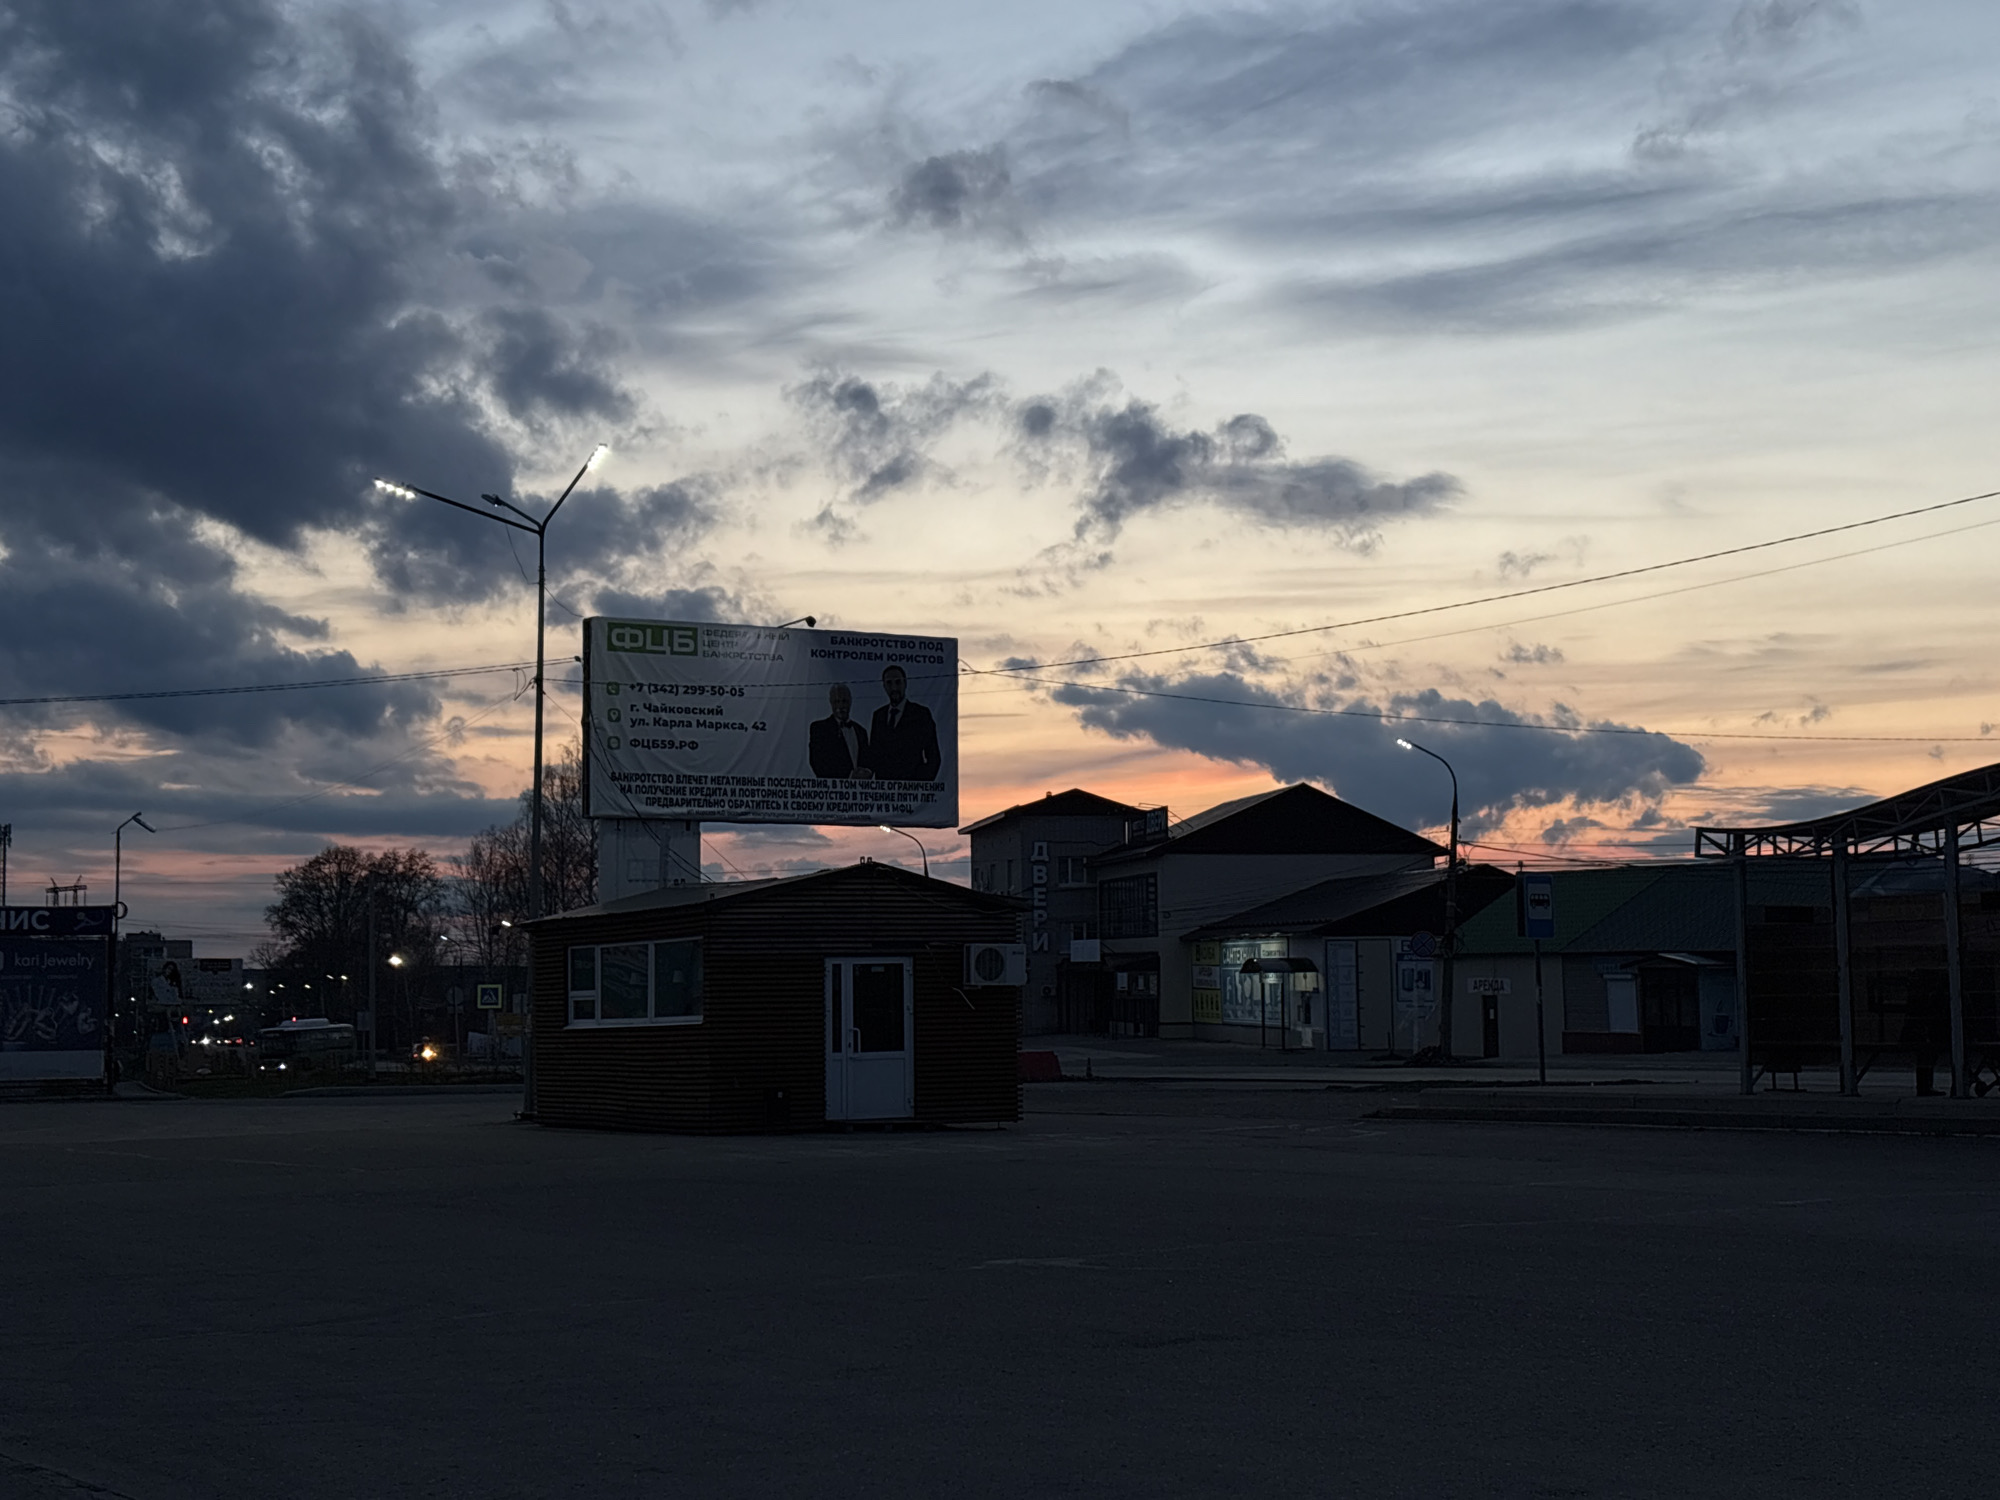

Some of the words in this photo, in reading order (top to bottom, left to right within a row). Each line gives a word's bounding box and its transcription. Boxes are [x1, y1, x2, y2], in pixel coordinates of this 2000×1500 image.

[611, 627, 695, 653] ФЦБ
[830, 636, 916, 649] БАНКРОТСТВО
[919, 641, 944, 652] ПОД
[811, 649, 883, 661] КОНТРОЛЕМ
[887, 654, 944, 664] ЮРИСТОВ
[629, 683, 644, 692] +7
[648, 684, 679, 696] (342)
[683, 685, 745, 698] 299-50-05
[630, 704, 639, 712] г.
[643, 703, 723, 716] Чайковский
[630, 718, 649, 728] ул.
[653, 717, 692, 730] Карла
[696, 719, 748, 732] Маркса,
[752, 722, 767, 731] 42
[630, 738, 699, 750] ФЦБ59.РФ
[611, 772, 674, 783] БАНКРОТСТВО
[676, 774, 708, 784] ВЛЕЧЕТ
[711, 775, 765, 787] НЕГАТИВНЫЕ
[767, 777, 830, 791] ПОСЛЕДСТВИЯ,
[832, 780, 837, 789] В
[840, 780, 856, 789] ТОМ
[858, 780, 885, 790] ЧИСЛЕ
[887, 781, 945, 792] ОГРАНИЧЕНИЯ
[620, 784, 633, 794] НА
[635, 784, 686, 796] ПОЛУЧЕНИЕ
[689, 786, 728, 798] КРЕДИТА
[731, 788, 736, 797] И
[739, 788, 789, 799] ПОВТОРНОЕ
[791, 790, 850, 801] БАНКРОТСТВО
[852, 791, 857, 800] В
[860, 791, 895, 802] ТЕЧЕНИЕ
[898, 793, 918, 802] ПЯТИ
[920, 793, 937, 803] ЛЕТ.
[646, 797, 725, 808] ПРЕДВАРИТЕЛЬНО
[728, 799, 781, 811] ОБРАТИТЕСЬ
[783, 801, 789, 810] К
[791, 802, 824, 811] СВОЕМУ
[827, 803, 874, 813] КРЕДИТОРУ
[877, 804, 882, 812] И
[885, 804, 890, 812] В
[892, 804, 914, 814] МФЦ.
[1030, 841, 1050, 953] ДВЕРИ
[14, 952, 39, 967] kari
[1473, 979, 1505, 992] АРЕНДА
